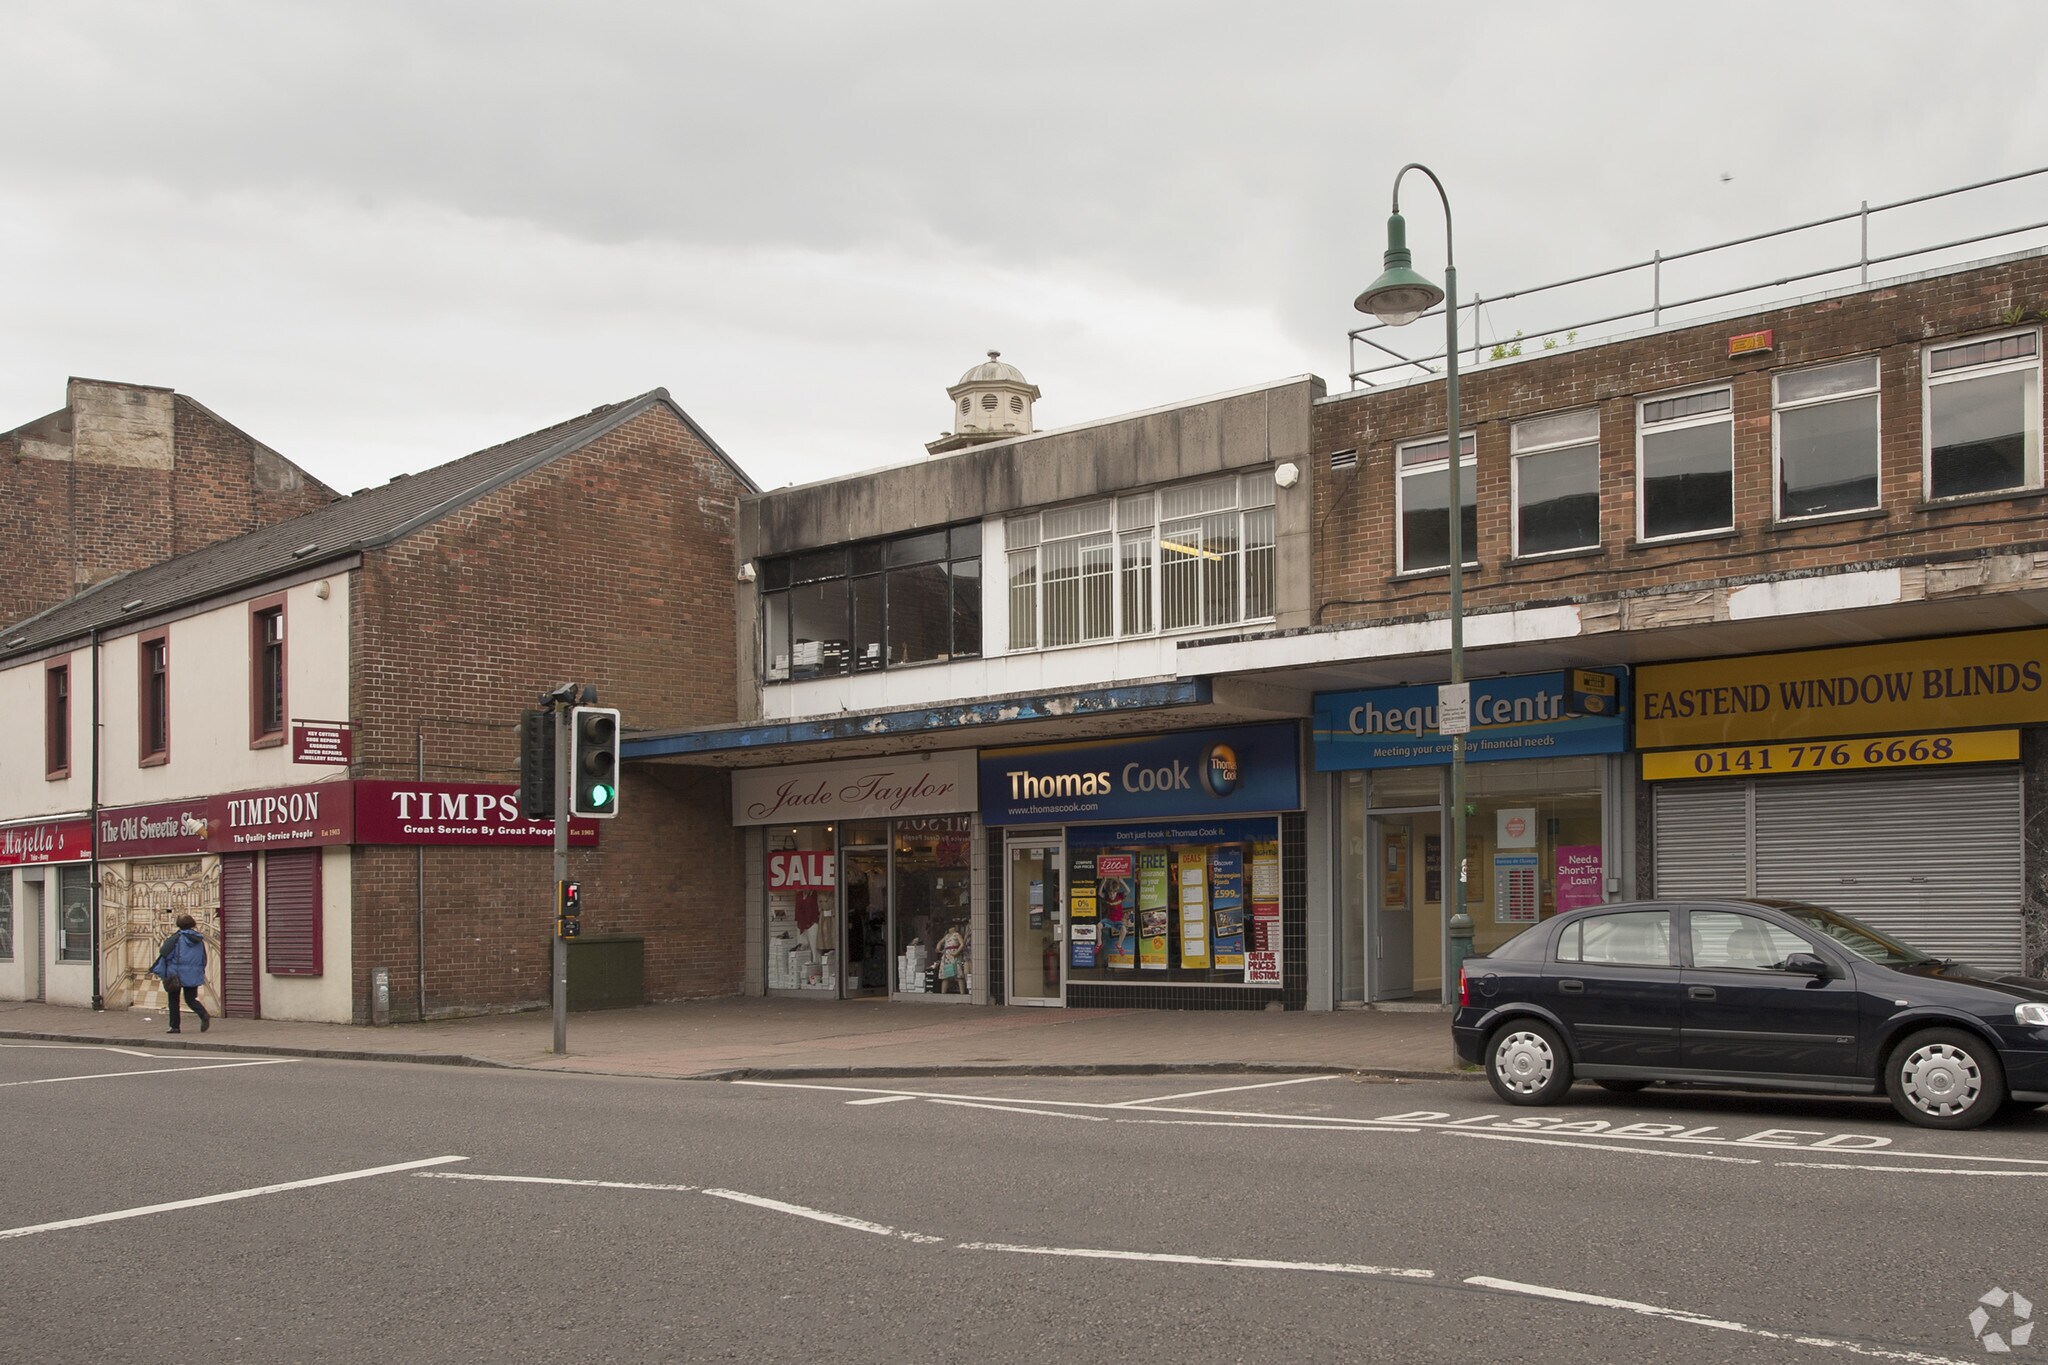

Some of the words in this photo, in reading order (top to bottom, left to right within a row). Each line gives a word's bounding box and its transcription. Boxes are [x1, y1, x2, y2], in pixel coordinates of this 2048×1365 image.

[1643, 684, 1770, 720] EASTEND
[1779, 672, 1914, 710] WINDOW
[1923, 661, 2042, 700] BLINDS
[1349, 702, 1440, 738] Chequ
[1475, 690, 1584, 725] Centr
[1373, 745, 1411, 758] Meeting
[1412, 746, 1433, 757] your
[1480, 737, 1522, 749] financial
[1524, 736, 1555, 746] needs
[1694, 748, 1774, 774] 0141
[1788, 743, 1851, 768] 776
[1864, 737, 1953, 764] 6668
[1211, 758, 1238, 770] Thomas
[1007, 770, 1112, 800] Thomas
[1122, 760, 1191, 792] Cook
[1222, 770, 1238, 781] Cook
[747, 779, 833, 820] Jade
[839, 772, 954, 811] Taylor
[227, 792, 319, 828] TIMPSON
[391, 791, 571, 823] TIMPS
[1008, 802, 1098, 815] www.thomascook.com
[101, 820, 118, 843] The
[120, 816, 138, 842] Old
[140, 816, 179, 840] Sweetie
[403, 824, 435, 834] Great
[437, 825, 478, 835] Service
[481, 826, 495, 836] By
[498, 826, 526, 836] Great
[528, 827, 557, 837] Peopl
[1116, 831, 1134, 840] Don't
[1134, 830, 1147, 840] just
[1147, 830, 1164, 838] book
[1171, 828, 1198, 838] Thomas
[1199, 828, 1217, 836] Cook
[2, 825, 64, 860] Majella's
[233, 835, 244, 843] The
[245, 832, 266, 844] Quality
[267, 831, 290, 840] Service
[292, 830, 313, 840] People
[1100, 860, 1122, 870] £200
[1141, 854, 1165, 868] FREE
[1182, 854, 1202, 864] DEALS
[1569, 855, 1591, 864] Need
[770, 854, 836, 887] SALE
[1558, 866, 1585, 875] Short
[1570, 877, 1598, 885] Loan?
[1214, 890, 1235, 898] £599
[1077, 900, 1090, 908] 0%
[1248, 961, 1277, 971] PRICES
[1375, 1110, 1893, 1150] DISABLED
